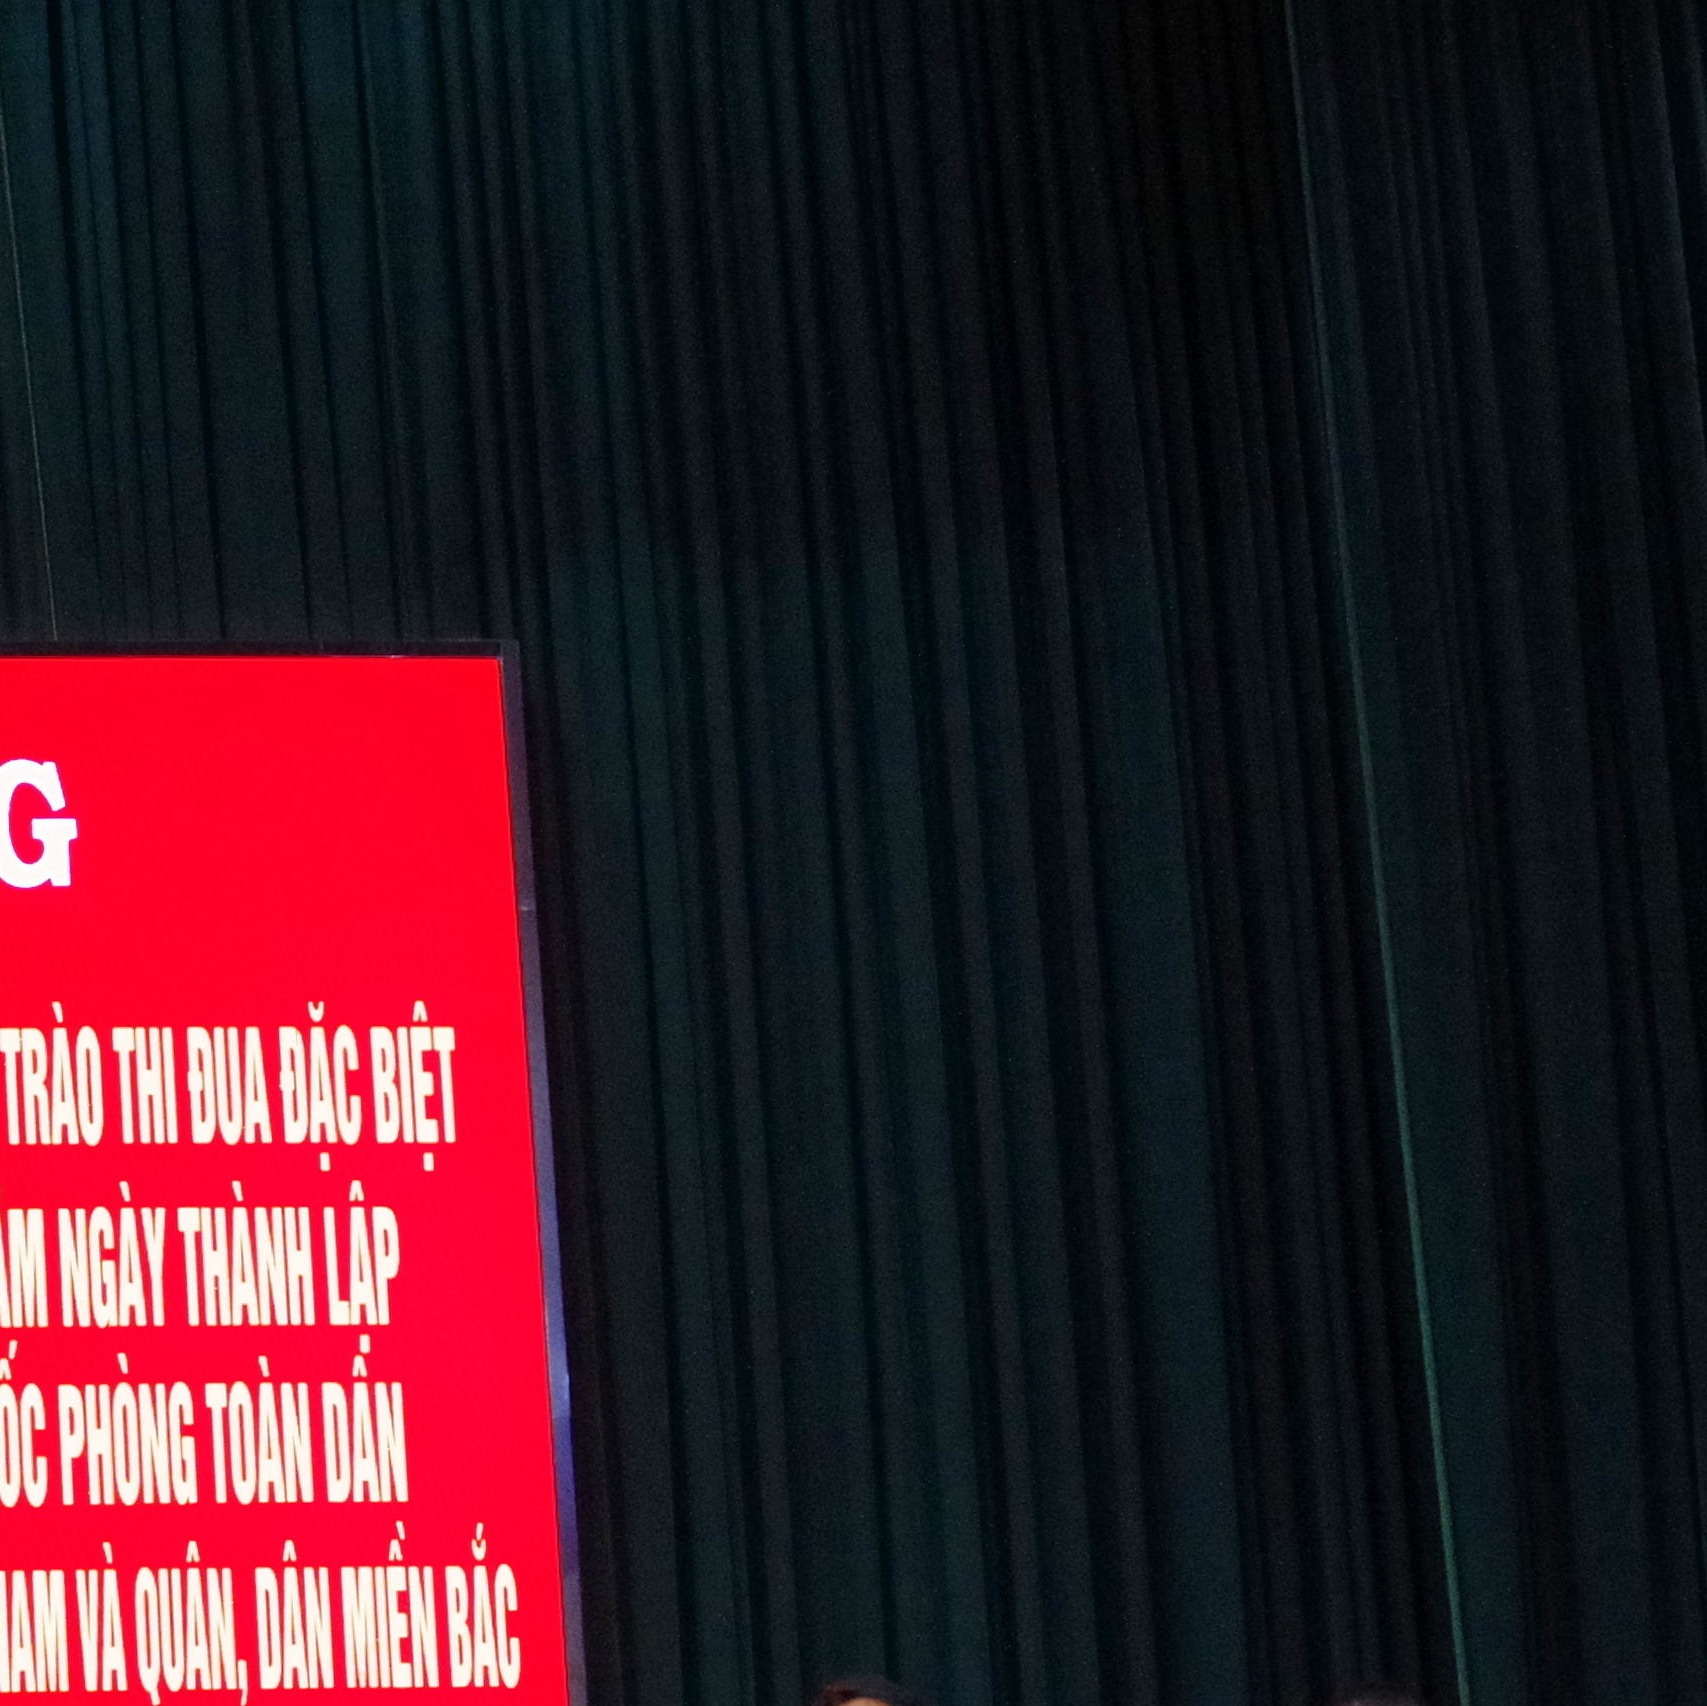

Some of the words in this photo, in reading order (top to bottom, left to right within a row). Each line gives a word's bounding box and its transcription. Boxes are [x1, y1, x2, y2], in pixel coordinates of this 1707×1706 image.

[112, 1027, 178, 1144] THI
[187, 1027, 272, 1145] ĐUA
[279, 1001, 361, 1171] ĐẶC
[370, 1001, 455, 1171] BIỆT
[58, 1181, 165, 1328] NGÀY
[177, 1181, 315, 1326] THÀNH
[324, 1180, 399, 1353] LẬP
[58, 1353, 197, 1506] PHÒNG
[205, 1356, 314, 1505] TOÀN
[322, 1355, 408, 1502] DÂN
[76, 1542, 127, 1692] VÀ
[135, 1541, 248, 1706] QUÂN,
[255, 1540, 334, 1689] DÂN
[341, 1521, 439, 1688] MIỀN
[445, 1523, 520, 1688] BẮC
